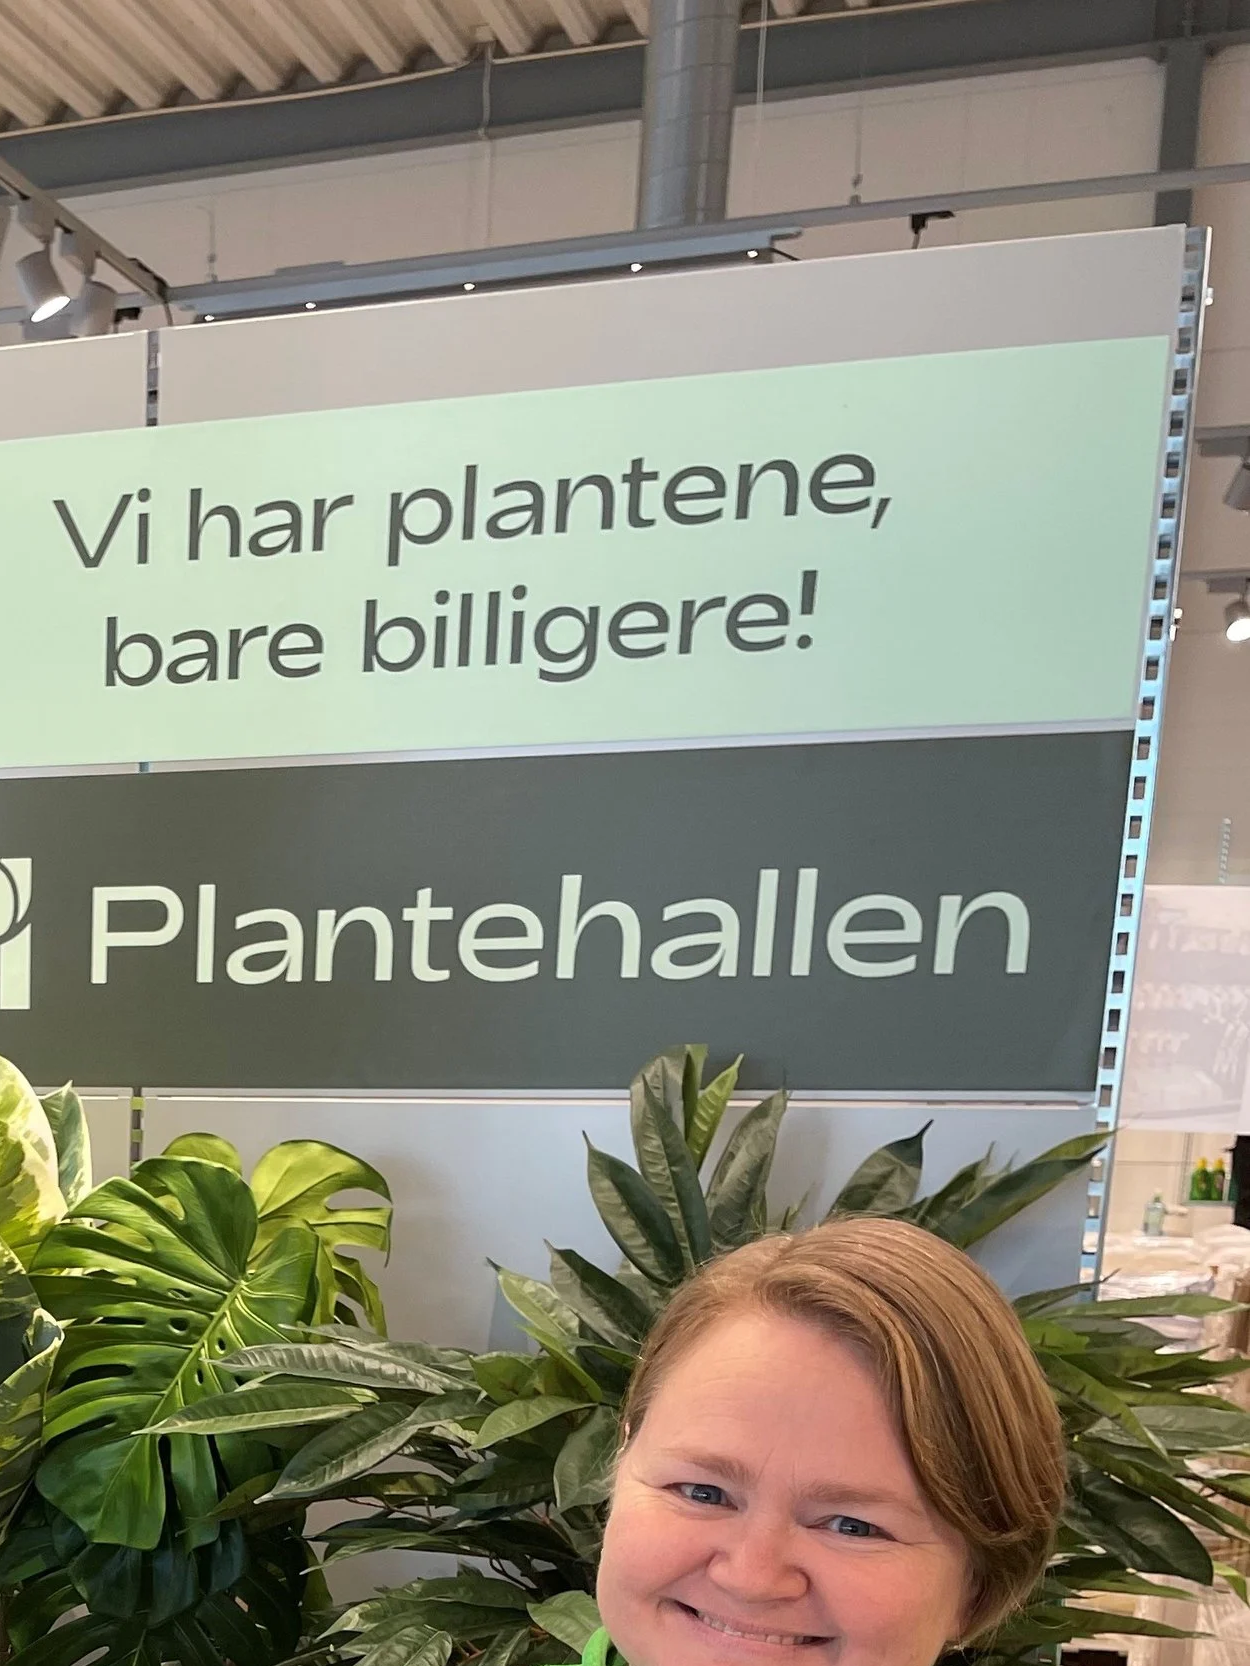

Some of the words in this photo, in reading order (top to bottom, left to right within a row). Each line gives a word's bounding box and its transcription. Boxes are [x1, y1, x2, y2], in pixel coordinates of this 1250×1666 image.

[53, 489, 151, 569] Vi
[186, 489, 354, 562] har
[385, 449, 893, 567] plantene,
[103, 616, 323, 687] bare
[361, 570, 819, 683] billigere!
[90, 866, 1030, 985] Plantehallen
